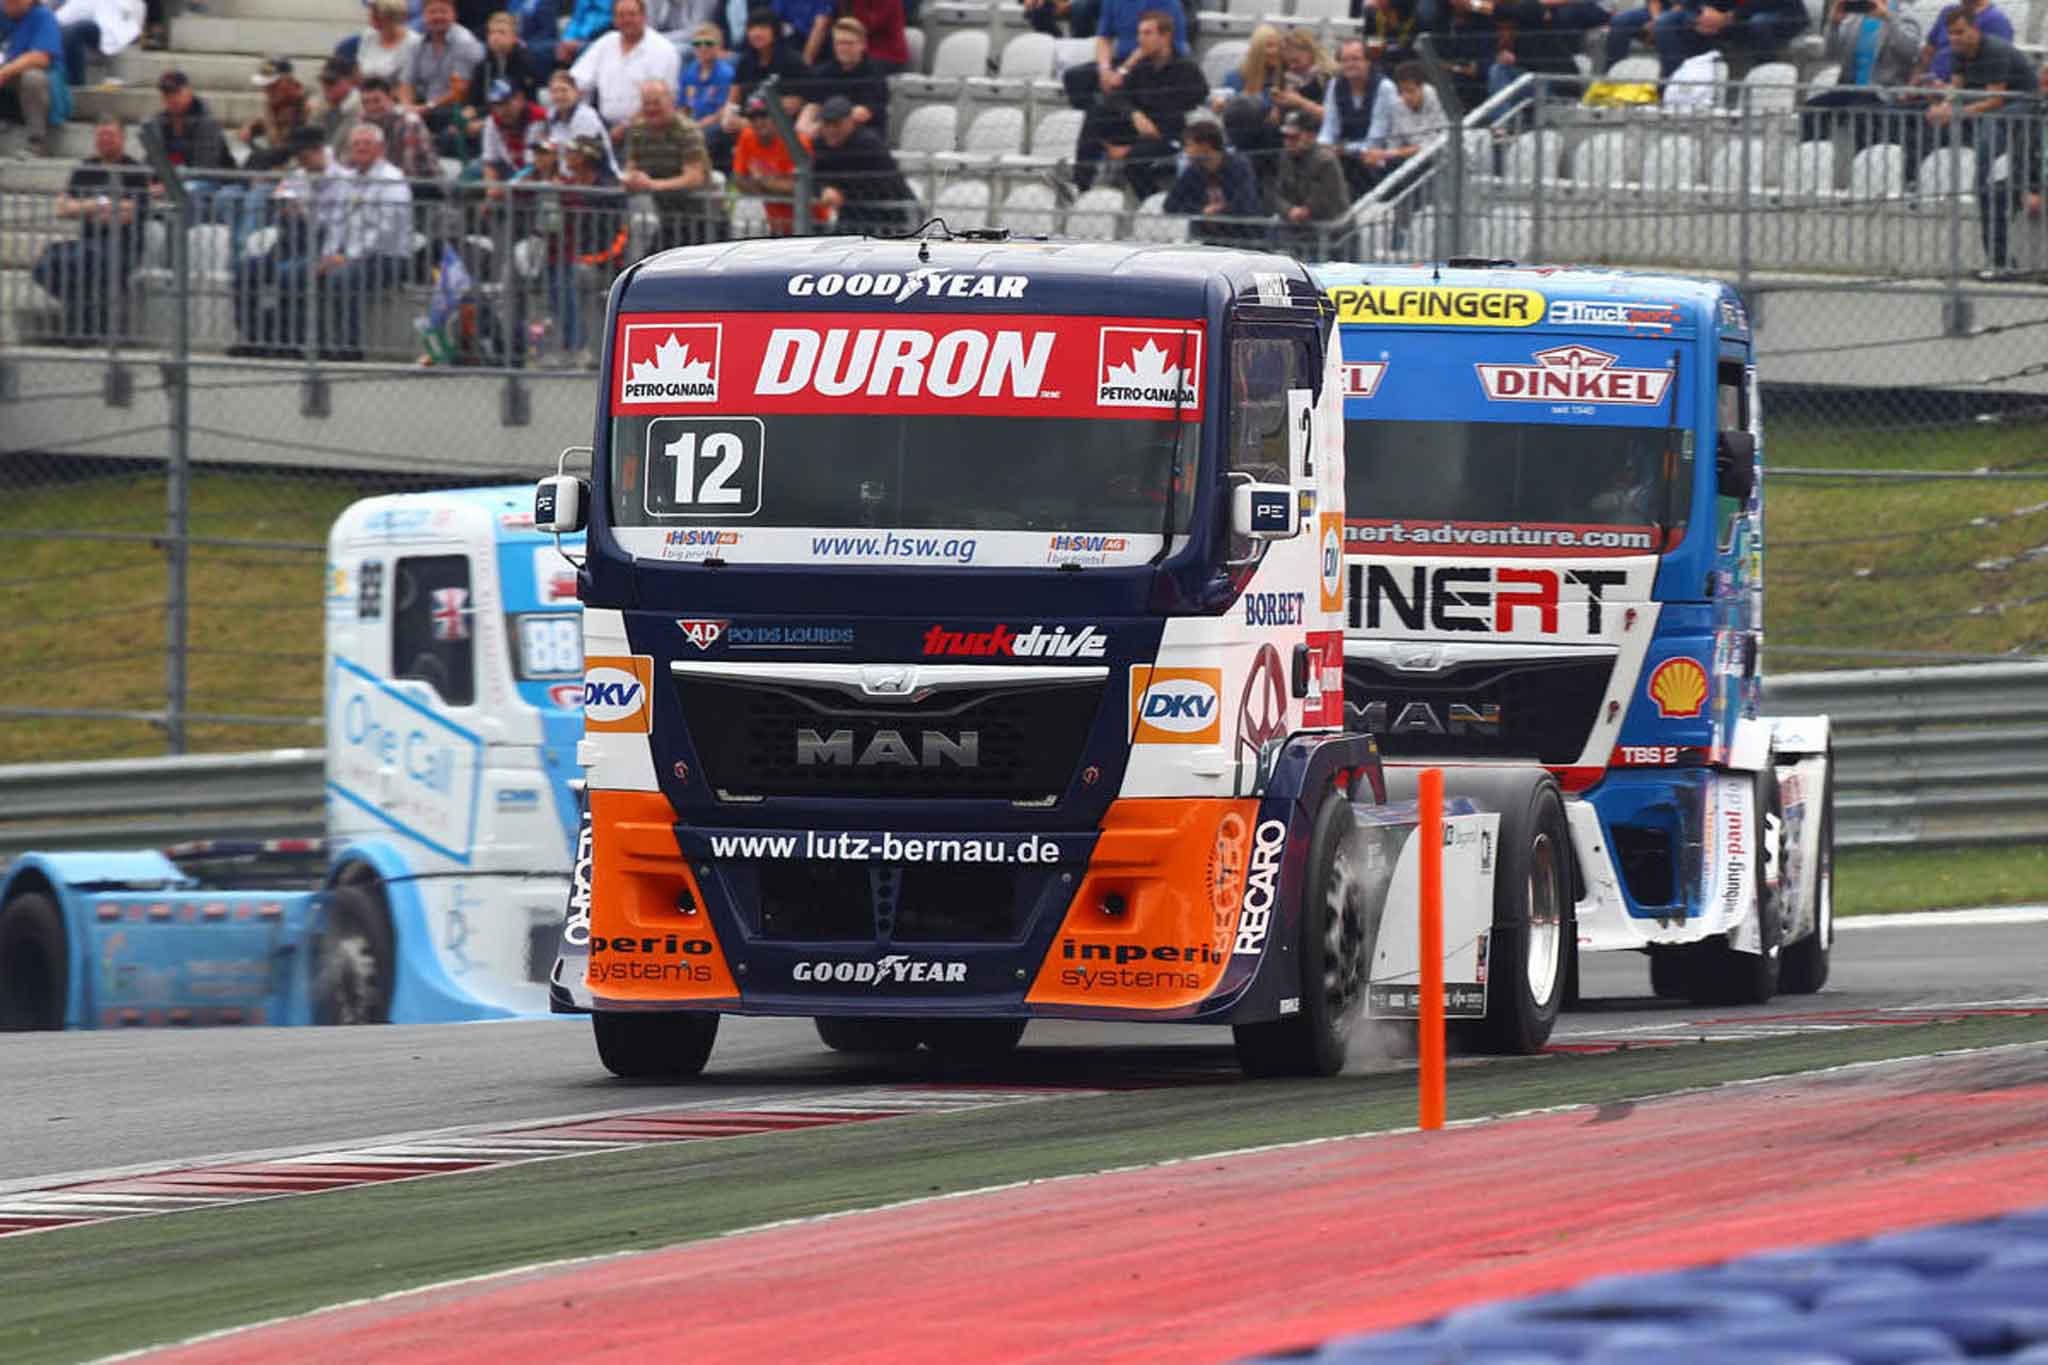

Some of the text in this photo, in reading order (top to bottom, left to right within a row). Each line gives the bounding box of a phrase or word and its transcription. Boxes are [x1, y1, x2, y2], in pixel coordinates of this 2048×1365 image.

[788, 271, 1029, 300] GOODYEAR
[1335, 290, 1530, 320] PALFINGER
[753, 328, 1056, 398] DURON
[1499, 371, 1655, 400] DINKEL
[665, 432, 744, 504] 12
[812, 533, 977, 562] www.hsw.ag
[1055, 535, 1105, 551] HSW
[1344, 522, 1651, 548] nert-adventure.com
[1245, 592, 1305, 626] BORBET
[1348, 564, 1628, 635] INERT
[686, 623, 720, 643] AD
[728, 627, 854, 643] POIDS LOURDS
[922, 624, 1108, 657] truckdrive
[585, 682, 641, 707] DKV
[1144, 694, 1216, 718] DKV
[797, 729, 978, 767] MAN
[1621, 746, 1661, 764] TBS
[711, 831, 1060, 863] www lutz-bernau.de
[1232, 819, 1287, 955] RECARO
[589, 960, 712, 982] systems
[793, 960, 967, 983] GOODYEAR
[1061, 966, 1201, 990] systems
